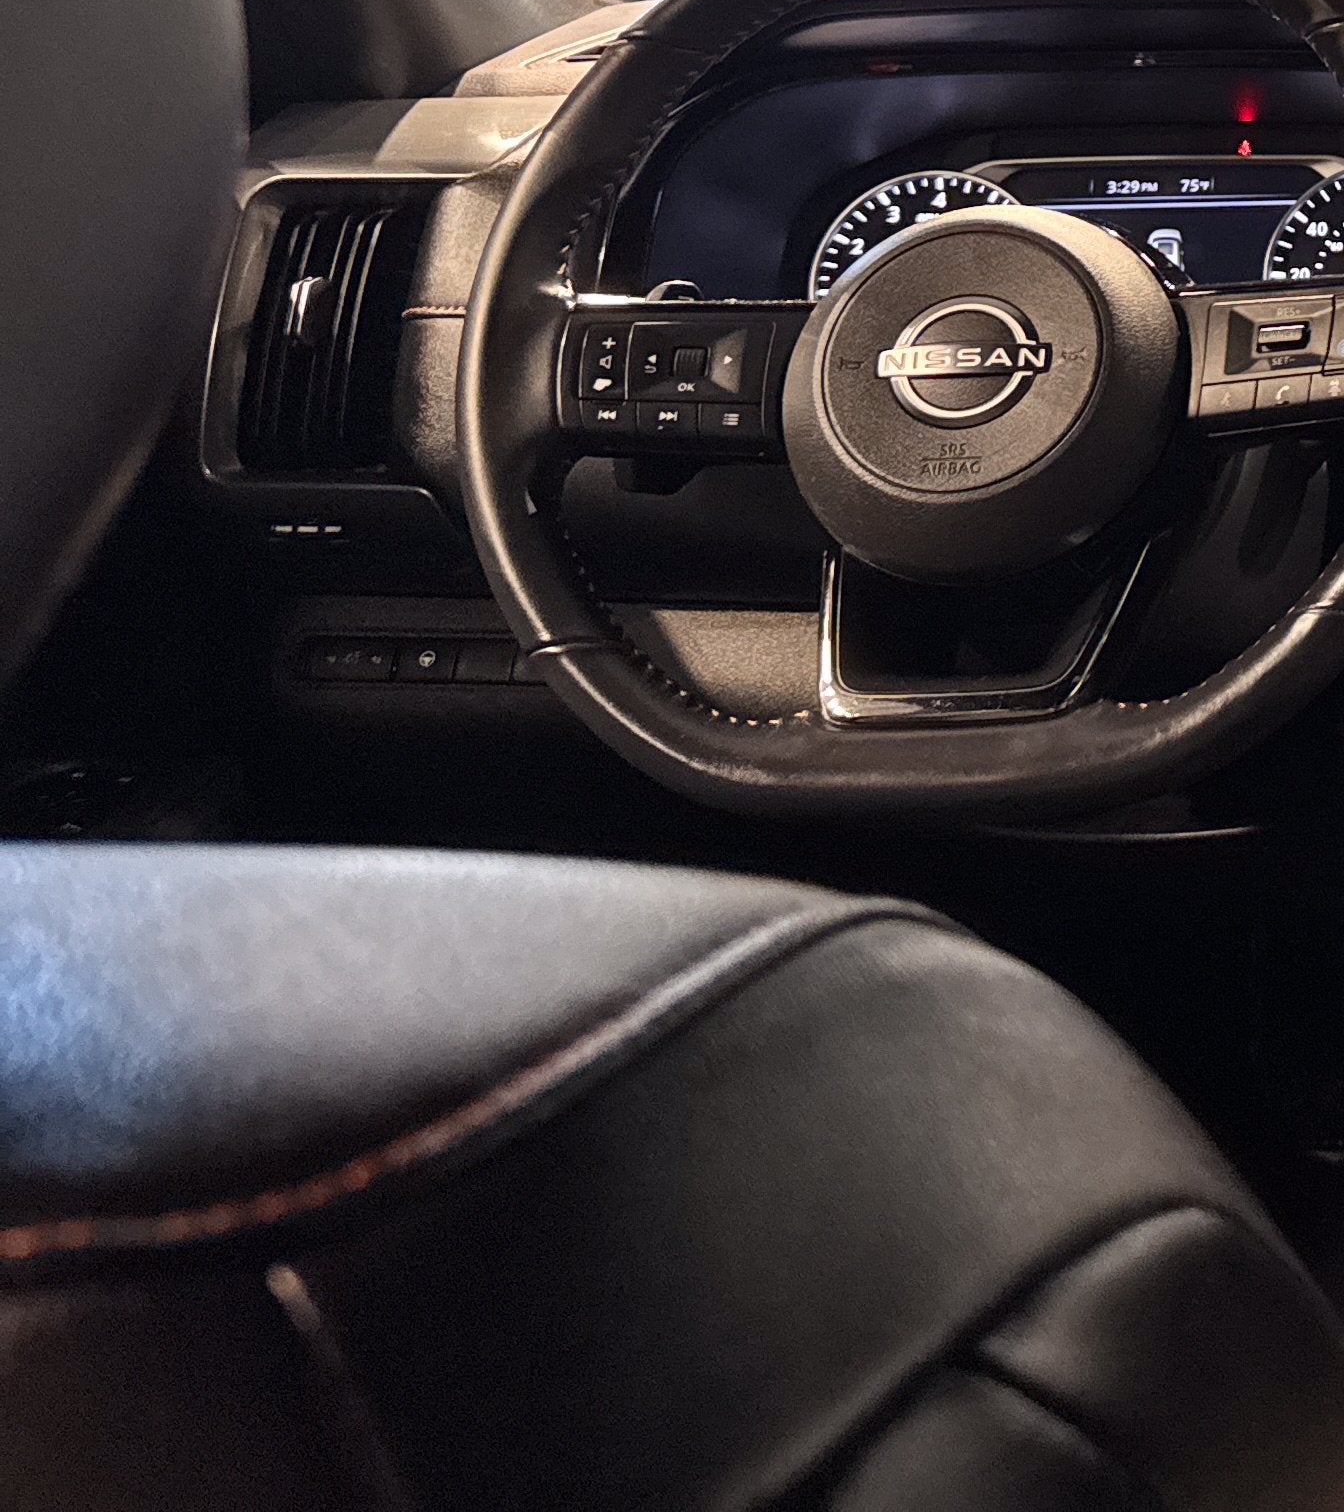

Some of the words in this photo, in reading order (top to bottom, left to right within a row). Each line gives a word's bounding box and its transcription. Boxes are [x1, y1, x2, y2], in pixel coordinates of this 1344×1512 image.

[929, 191, 948, 209] 4
[885, 205, 901, 224] 3
[1305, 221, 1329, 237] 40
[848, 238, 865, 256] 2
[1289, 267, 1311, 279] 20
[883, 347, 1047, 370] NISSAN
[677, 382, 697, 393] OK
[939, 442, 968, 457] SRS
[920, 460, 983, 477] AIRBAG
